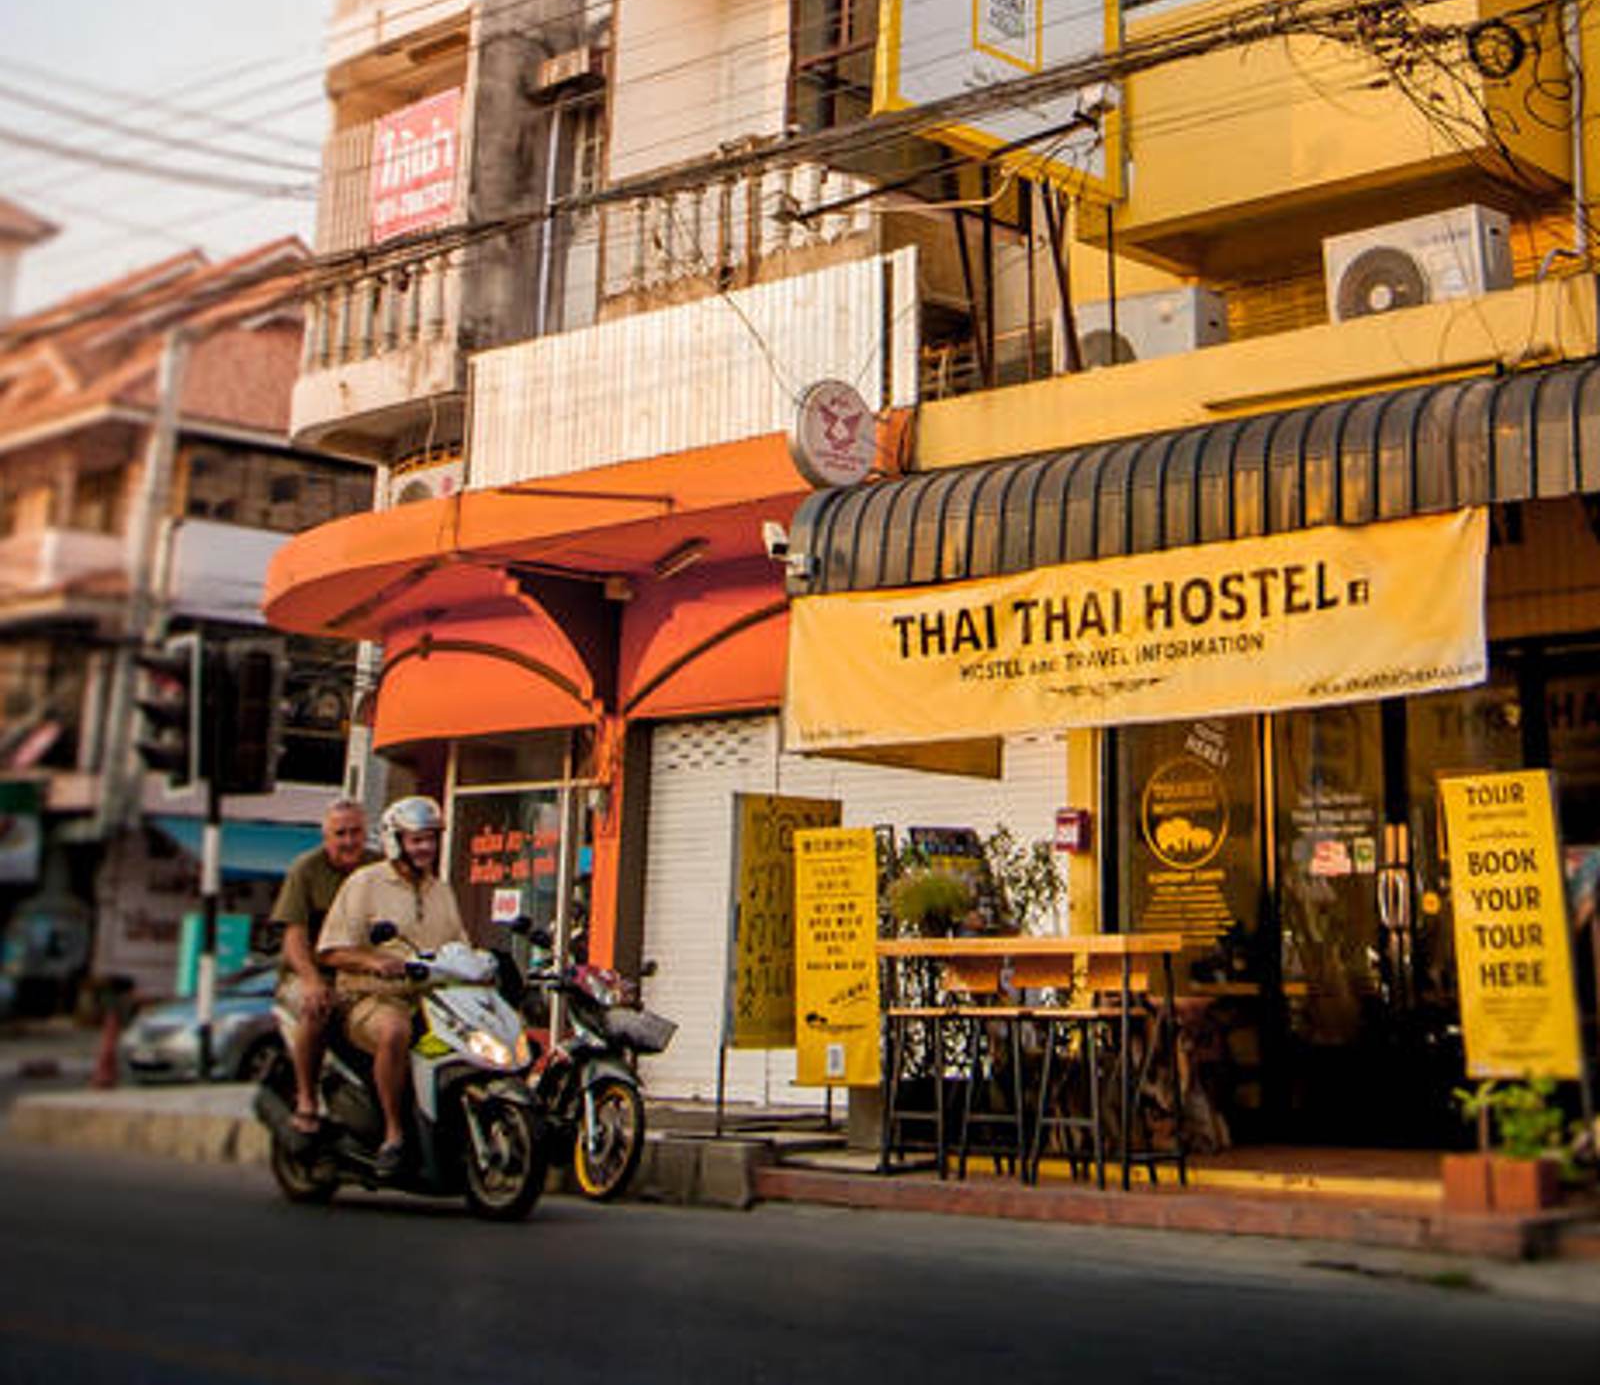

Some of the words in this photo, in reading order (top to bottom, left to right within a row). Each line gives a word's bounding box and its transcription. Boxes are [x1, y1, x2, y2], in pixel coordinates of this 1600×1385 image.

[891, 604, 998, 659] THAI
[1012, 588, 1123, 646] THAI
[1143, 560, 1339, 632] HOSTEL
[960, 659, 1025, 682] HOSTEL
[1064, 647, 1129, 672] TRAVEL
[1135, 632, 1265, 664] INFORMATION
[1464, 782, 1525, 807] TOUR
[1466, 847, 1539, 876] BOOK
[1470, 885, 1541, 913] YOUR
[1474, 924, 1544, 950] TOUR
[1480, 961, 1546, 988] HERE
